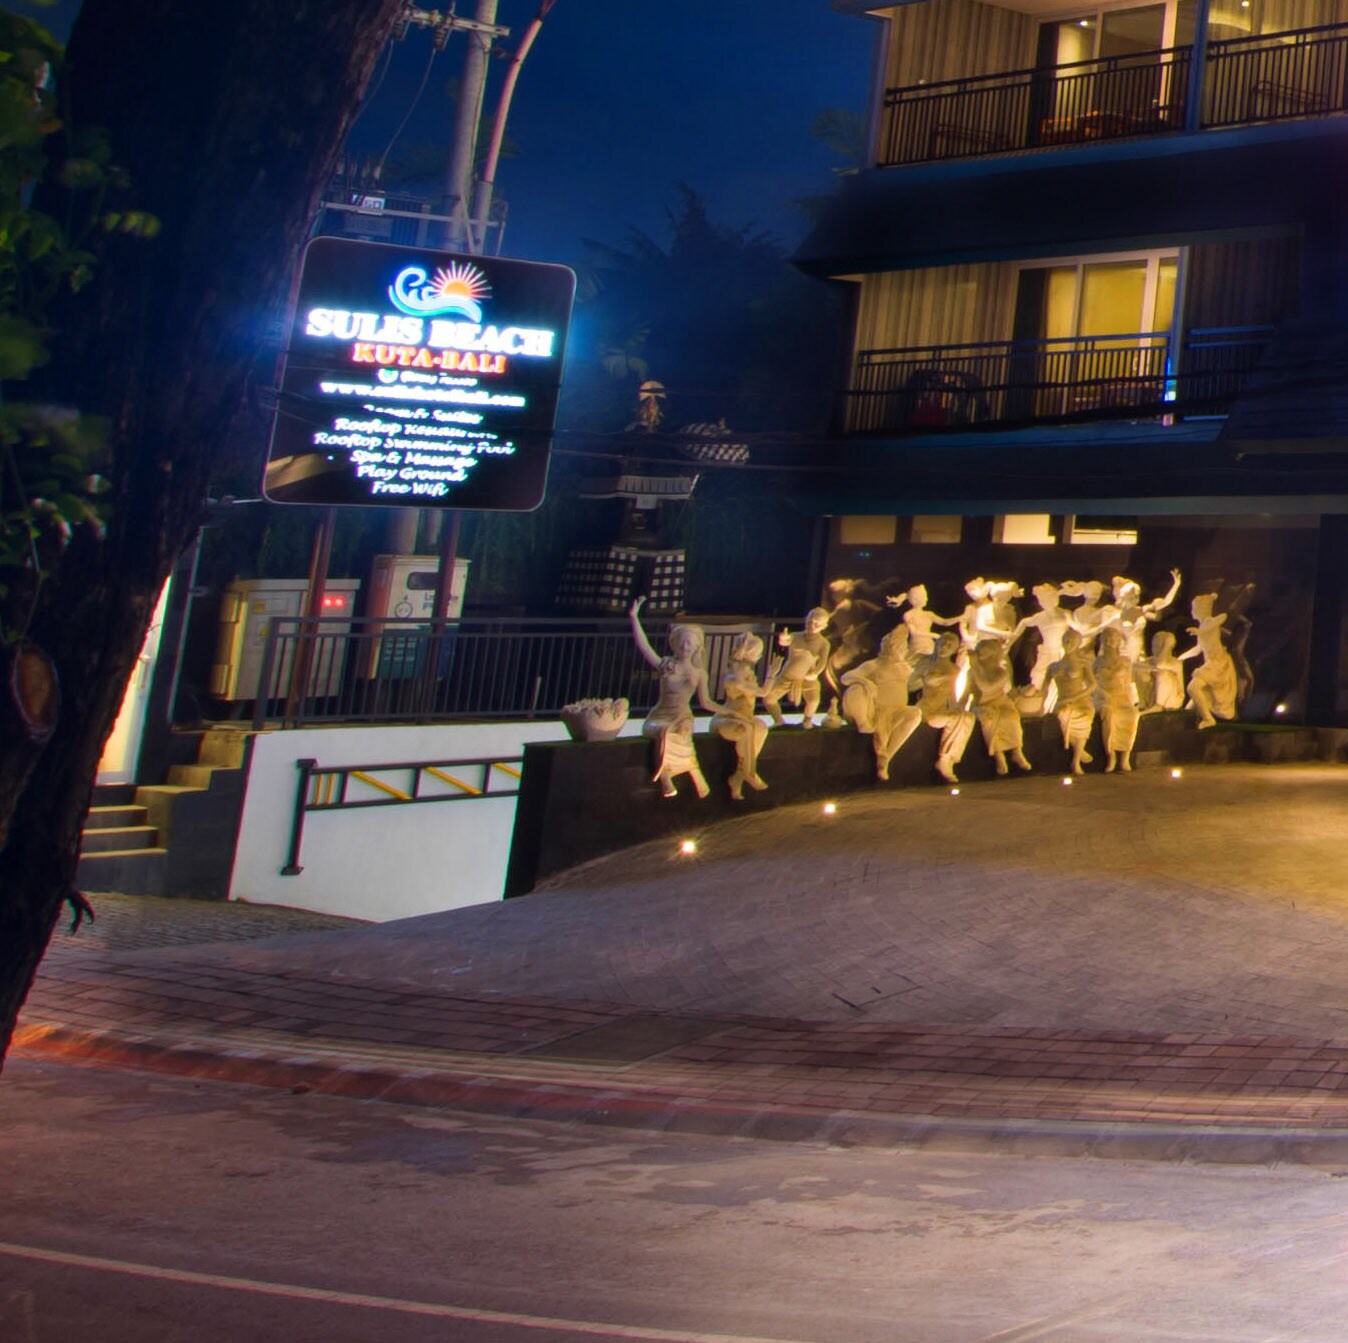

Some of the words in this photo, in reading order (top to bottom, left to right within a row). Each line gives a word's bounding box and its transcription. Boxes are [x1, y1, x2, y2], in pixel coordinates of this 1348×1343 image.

[306, 309, 423, 344] SULIS
[428, 320, 554, 357] BEACH
[334, 418, 402, 436] Rooftop
[313, 432, 382, 450] Rooftop
[357, 464, 398, 481] Play
[398, 467, 468, 482] Ground
[371, 481, 412, 494] Free
